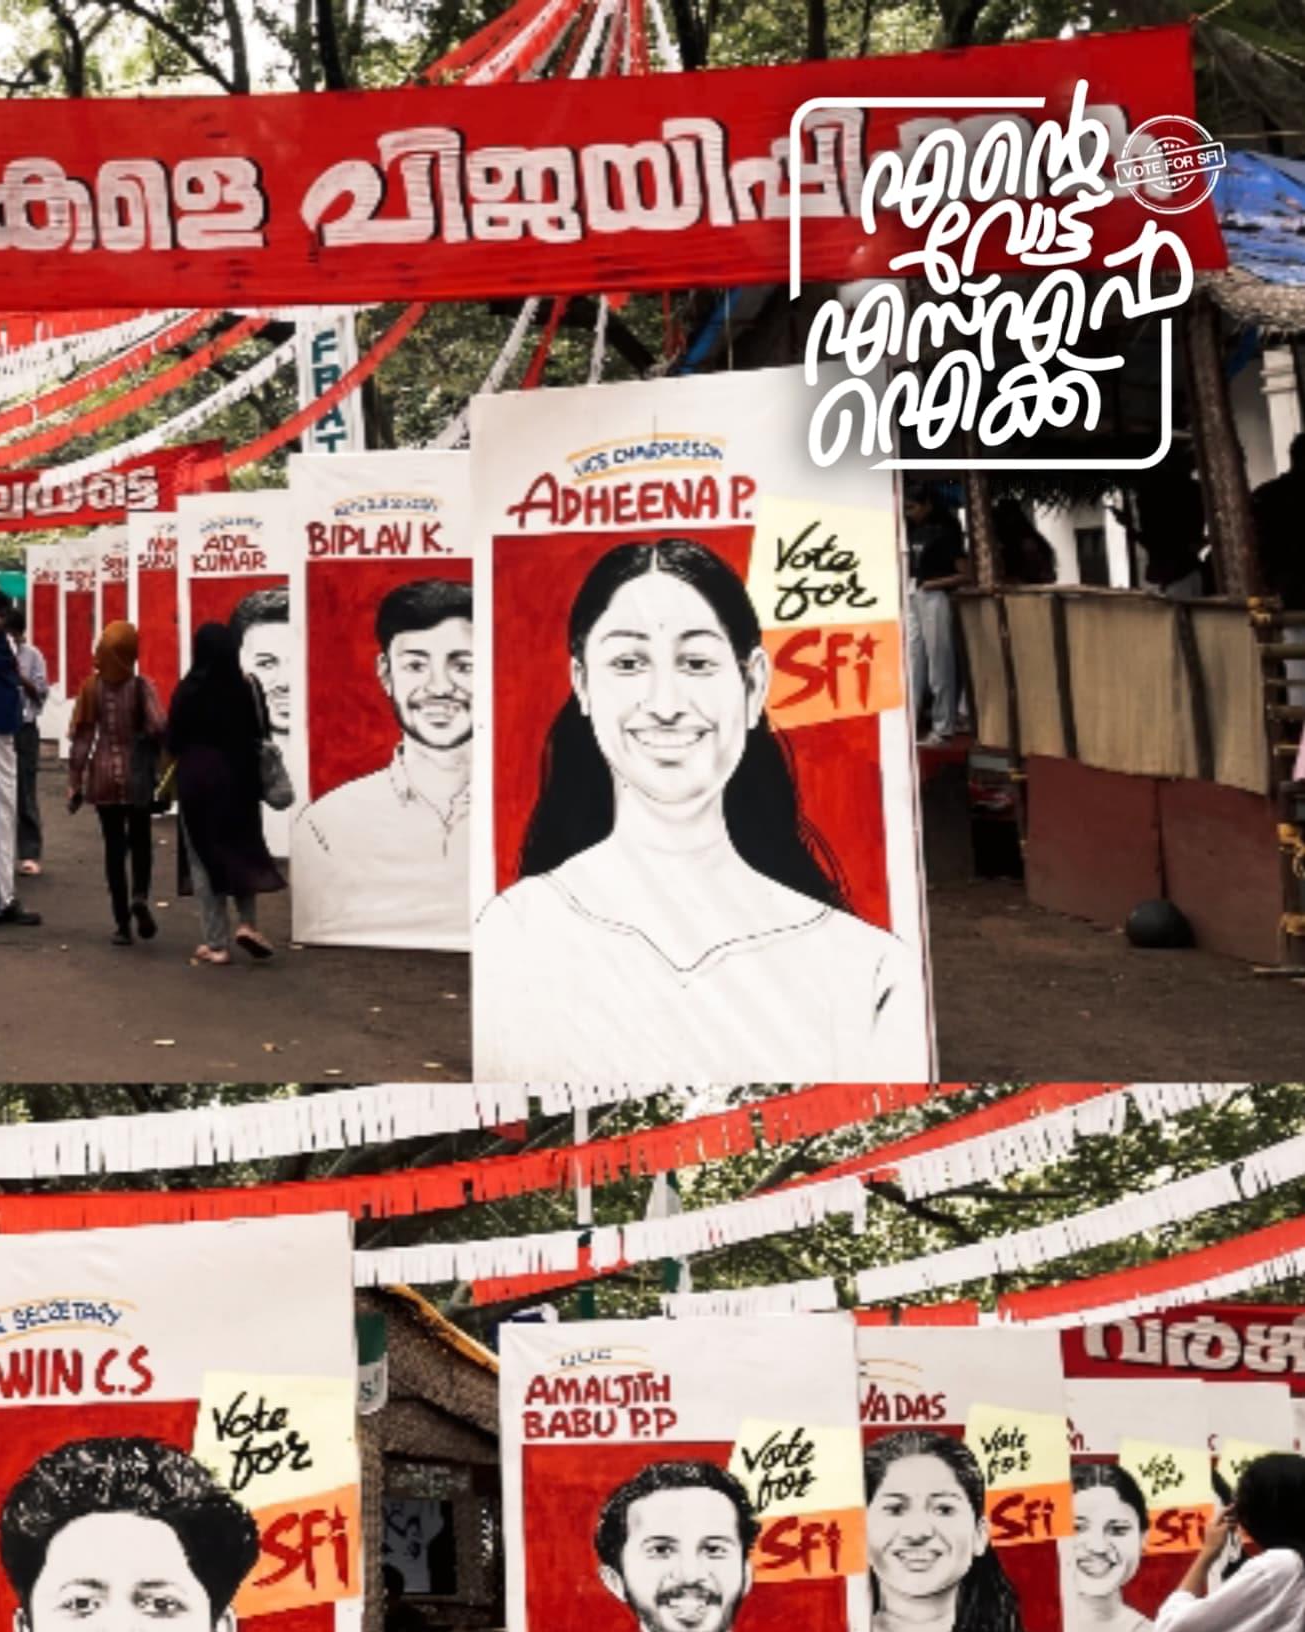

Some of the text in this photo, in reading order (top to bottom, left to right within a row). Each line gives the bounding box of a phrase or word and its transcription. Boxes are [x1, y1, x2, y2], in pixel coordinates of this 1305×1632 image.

[506, 472, 756, 528] ADHEENA P.
[191, 551, 267, 574] KUMAR
[203, 534, 259, 552] ADIL
[305, 521, 411, 556] BIPLAV
[422, 521, 454, 555] K.
[774, 521, 863, 573] Vote
[774, 571, 878, 621] for
[95, 1344, 155, 1397] C.S
[523, 1371, 672, 1410] AMALJITH
[212, 1391, 291, 1441] Vote
[522, 1408, 618, 1441] BABU
[229, 1429, 313, 1491] for
[741, 1427, 815, 1474] Vote
